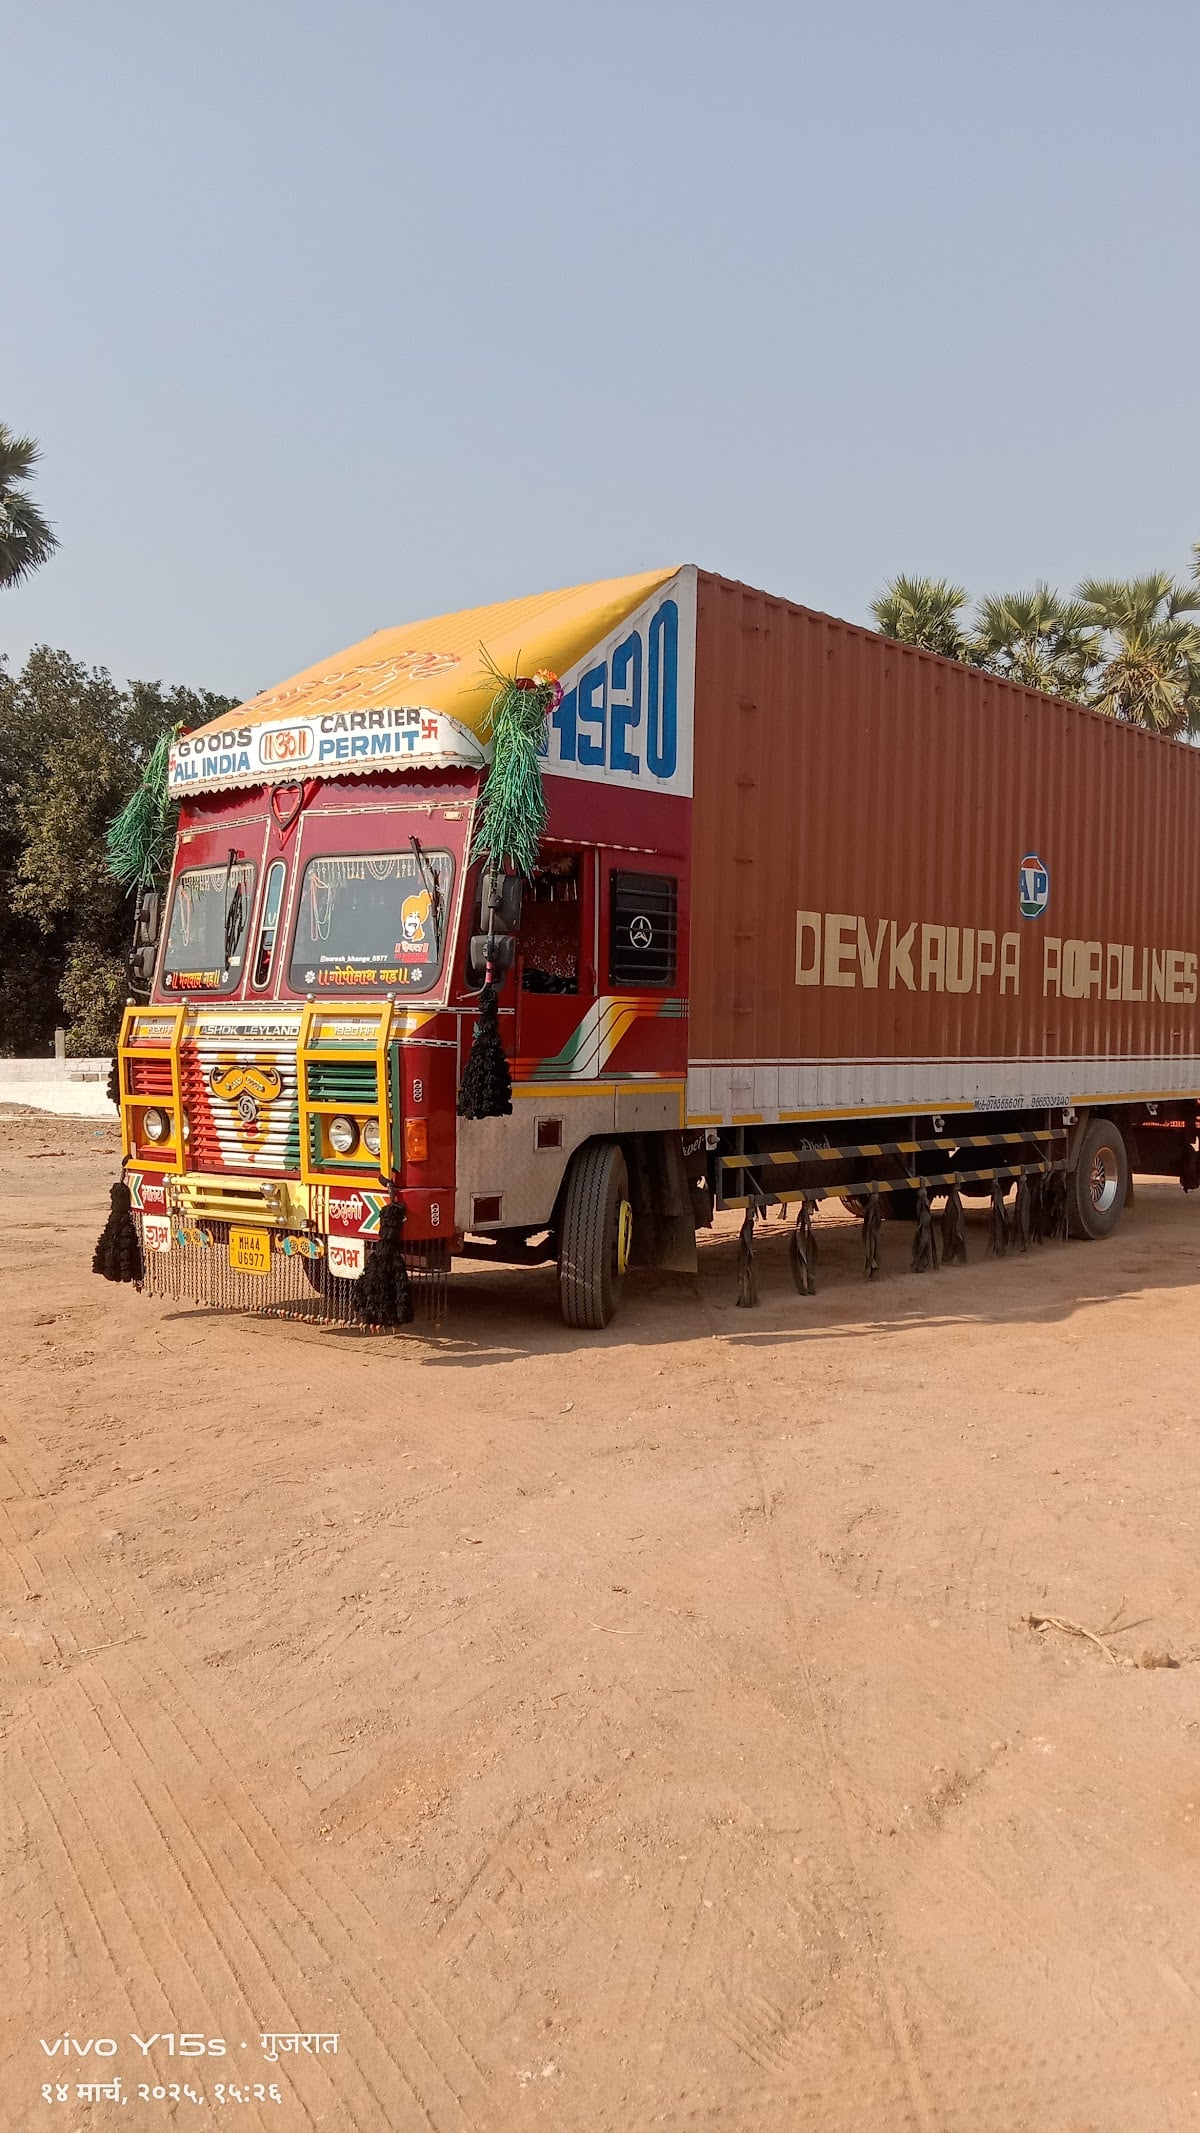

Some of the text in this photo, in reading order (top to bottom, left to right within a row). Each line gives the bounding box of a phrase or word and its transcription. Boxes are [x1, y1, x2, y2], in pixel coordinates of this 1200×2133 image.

[178, 709, 421, 757] GOODS CARRIER
[174, 730, 419, 781] ALL INDIA PERMIT
[1020, 870, 1047, 901] AP
[201, 1025, 300, 1036] ASHOK LEYLAND
[145, 1225, 168, 1251] शुभ
[239, 1236, 261, 1251] MH44
[238, 1251, 265, 1266] U6977
[330, 1247, 360, 1268] लाभ
